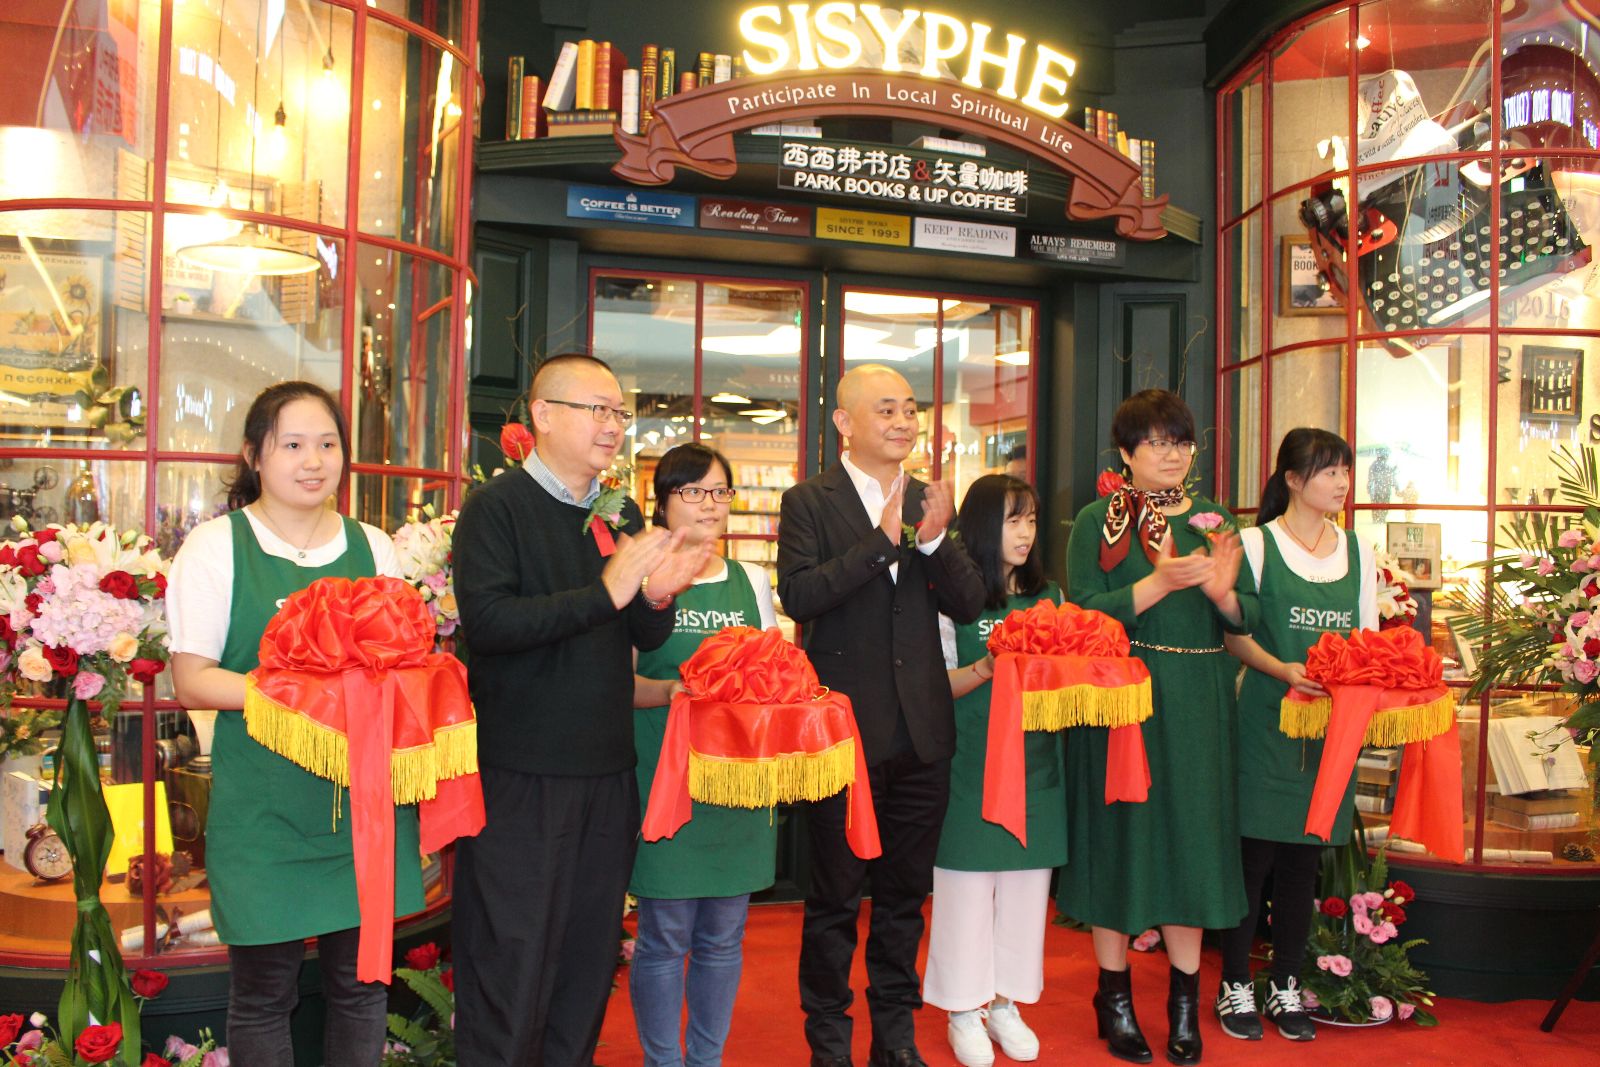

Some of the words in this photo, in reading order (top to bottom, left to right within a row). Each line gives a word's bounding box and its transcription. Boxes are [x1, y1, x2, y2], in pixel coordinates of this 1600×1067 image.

[738, 2, 1077, 118] SISYPHE
[727, 83, 837, 114] Participate
[851, 82, 871, 99] In
[886, 83, 937, 106] Local
[950, 93, 1029, 132] Spiritual
[1040, 125, 1073, 154] Life
[794, 171, 842, 192] PARK
[844, 177, 905, 199] BOOKS
[908, 185, 921, 201] &
[923, 186, 948, 203] UP
[950, 191, 1016, 213] COFFEE
[627, 203, 638, 211] IS
[640, 204, 682, 215] BETTER
[703, 204, 760, 224] Reading
[764, 206, 799, 223] Time
[826, 224, 864, 235] SINCE
[872, 229, 900, 239] 1993
[924, 223, 953, 236] KEEP
[958, 227, 1008, 240] READING
[1030, 235, 1066, 247] ALWAYS
[1070, 238, 1116, 251] REMEMBER
